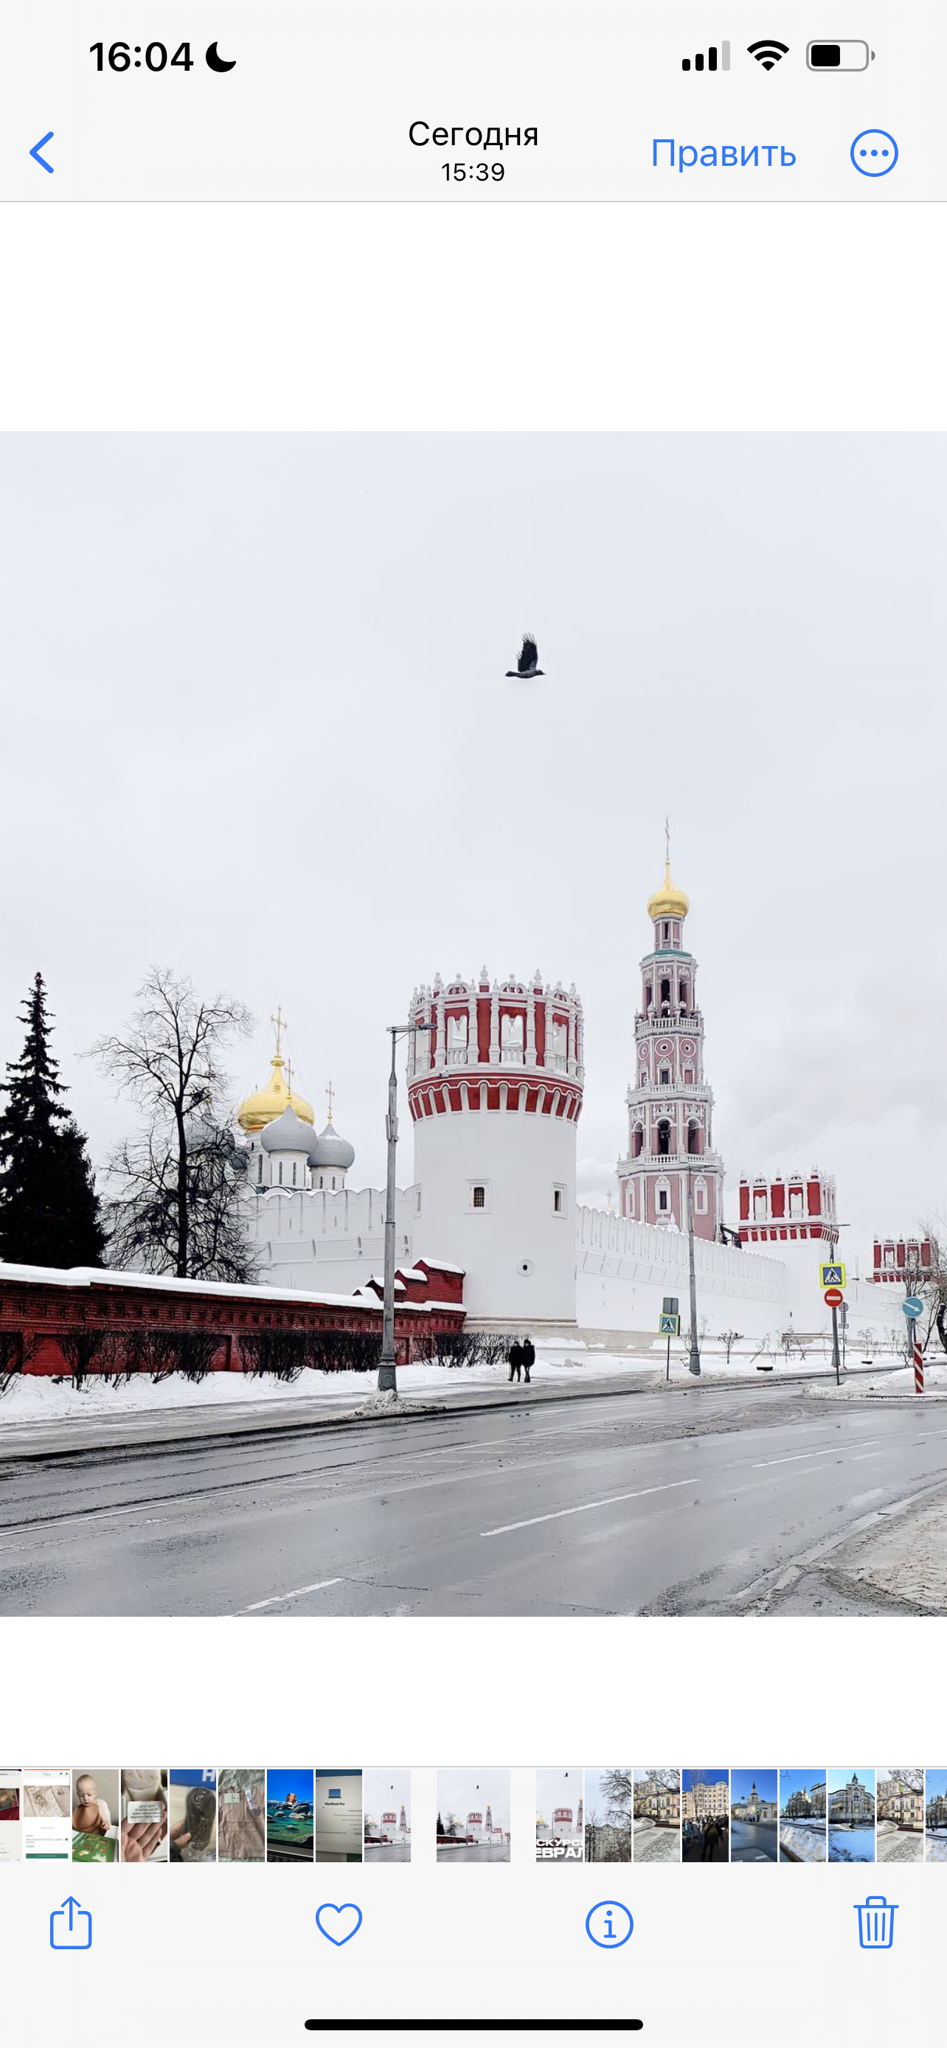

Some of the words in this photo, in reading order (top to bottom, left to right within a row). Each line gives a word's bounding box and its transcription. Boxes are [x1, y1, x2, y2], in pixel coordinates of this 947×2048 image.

[90, 42, 194, 72] 16:04
[408, 120, 538, 151] Сегодня
[652, 138, 797, 174] Править
[441, 162, 505, 182] 15:39
[536, 1839, 584, 1847] СКУРС
